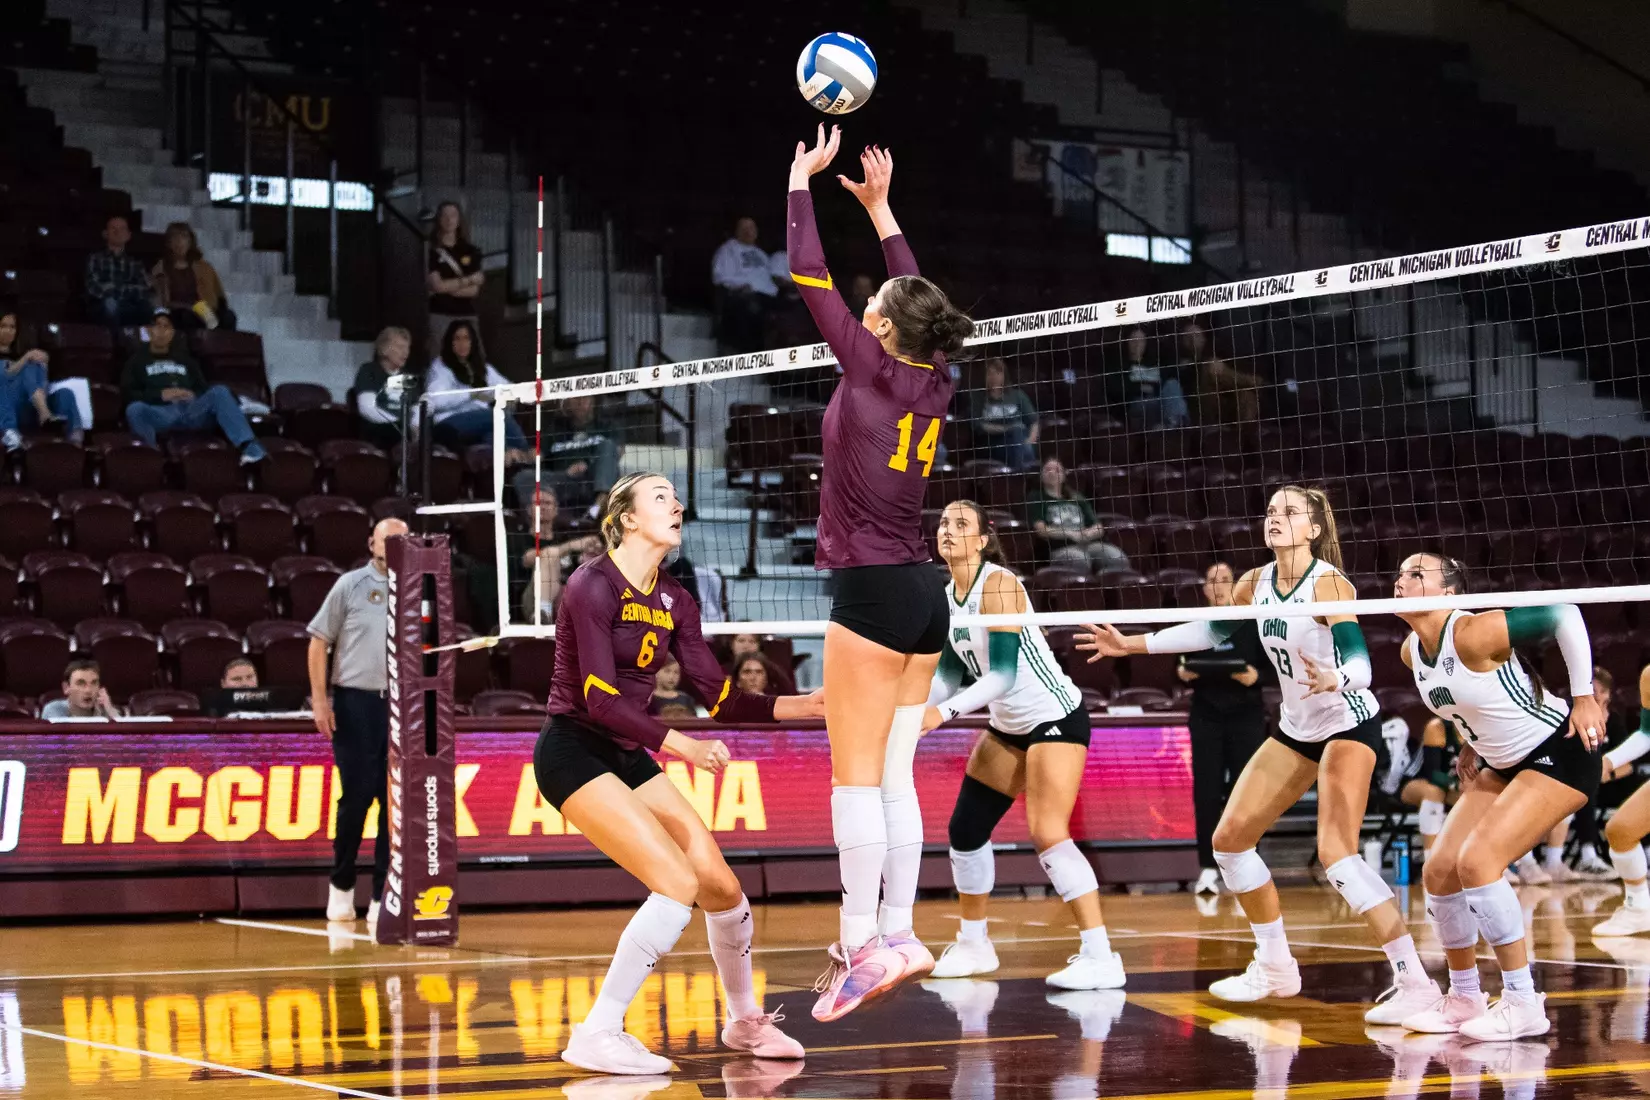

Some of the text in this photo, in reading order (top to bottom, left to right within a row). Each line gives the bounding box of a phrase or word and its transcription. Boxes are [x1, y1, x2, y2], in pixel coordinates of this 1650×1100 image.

[1585, 220, 1639, 248] CENTRAL
[1349, 239, 1523, 283] CENTRAL MICHIGAN VOLLEYBALL
[1146, 275, 1296, 313] CENTRAL MICHIGAN VOLLEYBALL
[973, 305, 1099, 339] ENTRAL MICHIGAN VOLLEYBALL
[672, 352, 775, 379] CENTRAL MICHIGAN VOLLEYBALL
[812, 344, 836, 361] CENT
[549, 371, 639, 394] CENTRAL MICHIGAN VOLLEYBALL
[888, 412, 941, 478] 14
[1262, 618, 1288, 641] OHIO
[637, 631, 659, 668] 6
[1428, 686, 1457, 710] OHIO
[385, 567, 403, 917] CENTRAL MICHIGAN
[62, 764, 481, 845] MCGU
[508, 760, 767, 836] ANA
[424, 775, 440, 877] sports imports
